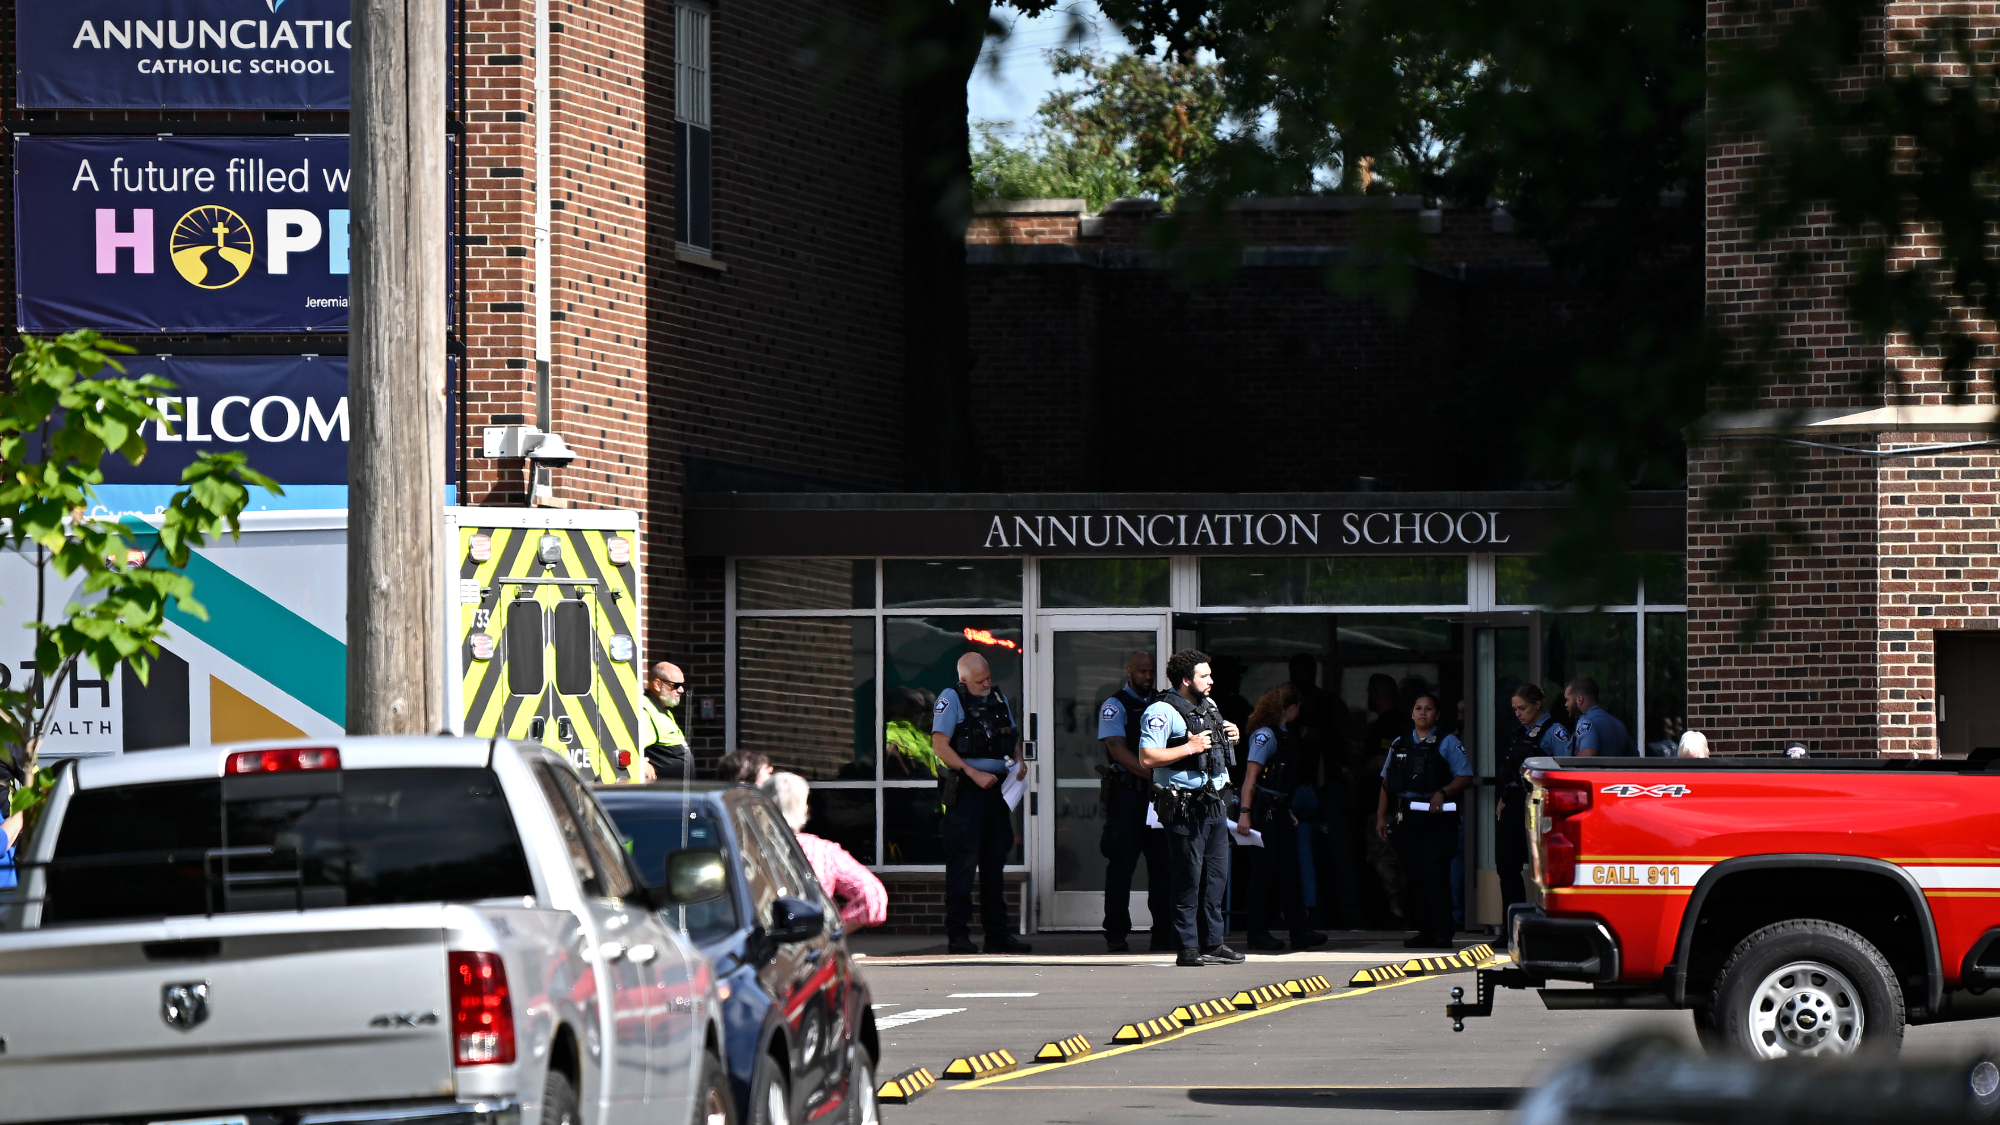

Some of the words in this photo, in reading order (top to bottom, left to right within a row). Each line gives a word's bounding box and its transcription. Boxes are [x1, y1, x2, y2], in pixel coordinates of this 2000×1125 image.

[73, 20, 351, 49] ANNUNCIATI
[138, 59, 241, 74] CATHOLIC
[250, 59, 334, 74] SCHOOL
[72, 159, 99, 192] A
[110, 157, 214, 193] future
[226, 157, 308, 193] filled
[96, 395, 351, 442] ELCOM
[984, 514, 1321, 547] ANNUNCIATION
[1343, 512, 1510, 544] SCHOOL
[563, 748, 592, 769] NCE
[1593, 866, 1639, 884] CALL
[1647, 866, 1680, 884] 911
